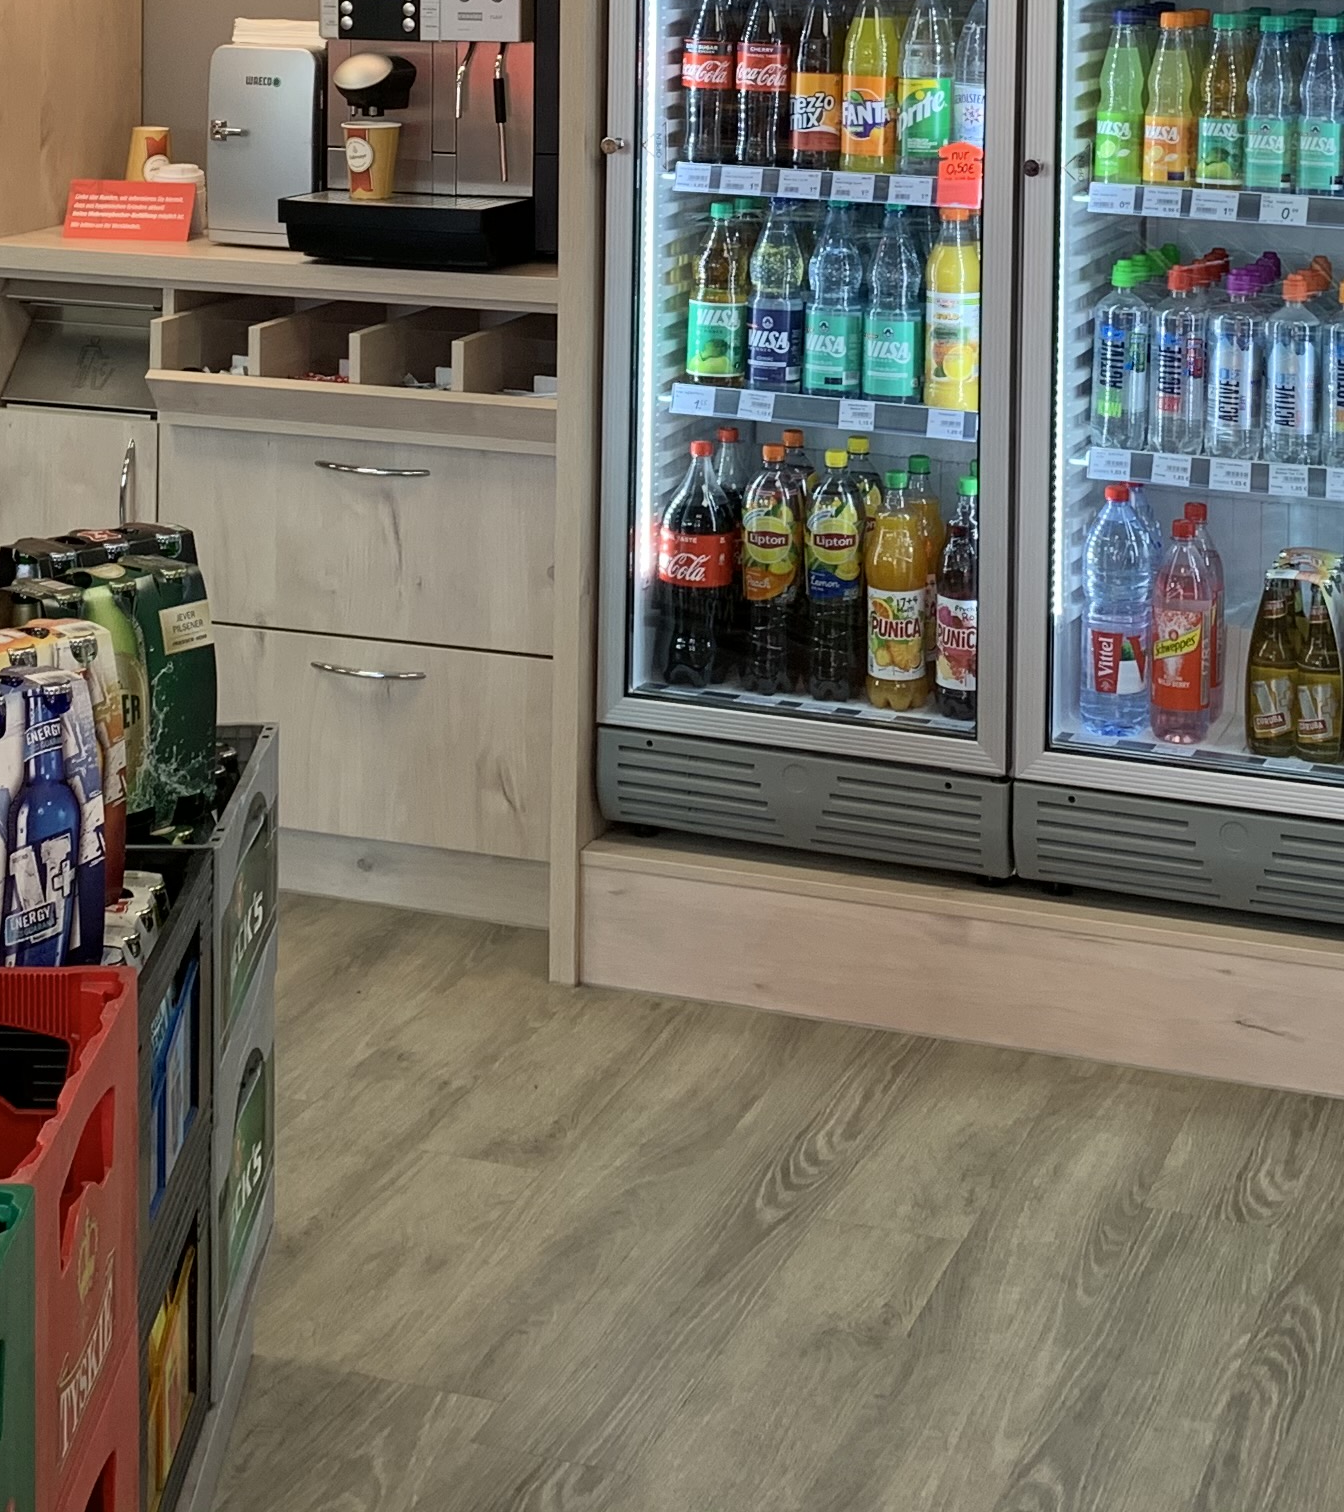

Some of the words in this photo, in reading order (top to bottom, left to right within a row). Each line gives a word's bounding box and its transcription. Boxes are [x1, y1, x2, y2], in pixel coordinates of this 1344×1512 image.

[246, 76, 272, 87] WAECO
[842, 100, 890, 125] FANTA
[1202, 120, 1240, 140] VILSA
[951, 152, 969, 161] nur
[946, 162, 974, 176] 0,50€
[696, 308, 740, 330] VILSA
[748, 328, 789, 354] VILSA
[807, 333, 846, 358] VILSA
[866, 340, 910, 364] VILSA
[1218, 369, 1240, 422] ACTIVE
[1274, 375, 1296, 428] ACTIVE
[748, 532, 787, 547] Lipton
[814, 534, 854, 549] Lipton
[810, 576, 839, 588] Lemon
[175, 611, 197, 623] JEVER
[1154, 632, 1199, 657] Schweppes
[1097, 636, 1115, 676] Vittel
[1173, 679, 1191, 689] BERRY
